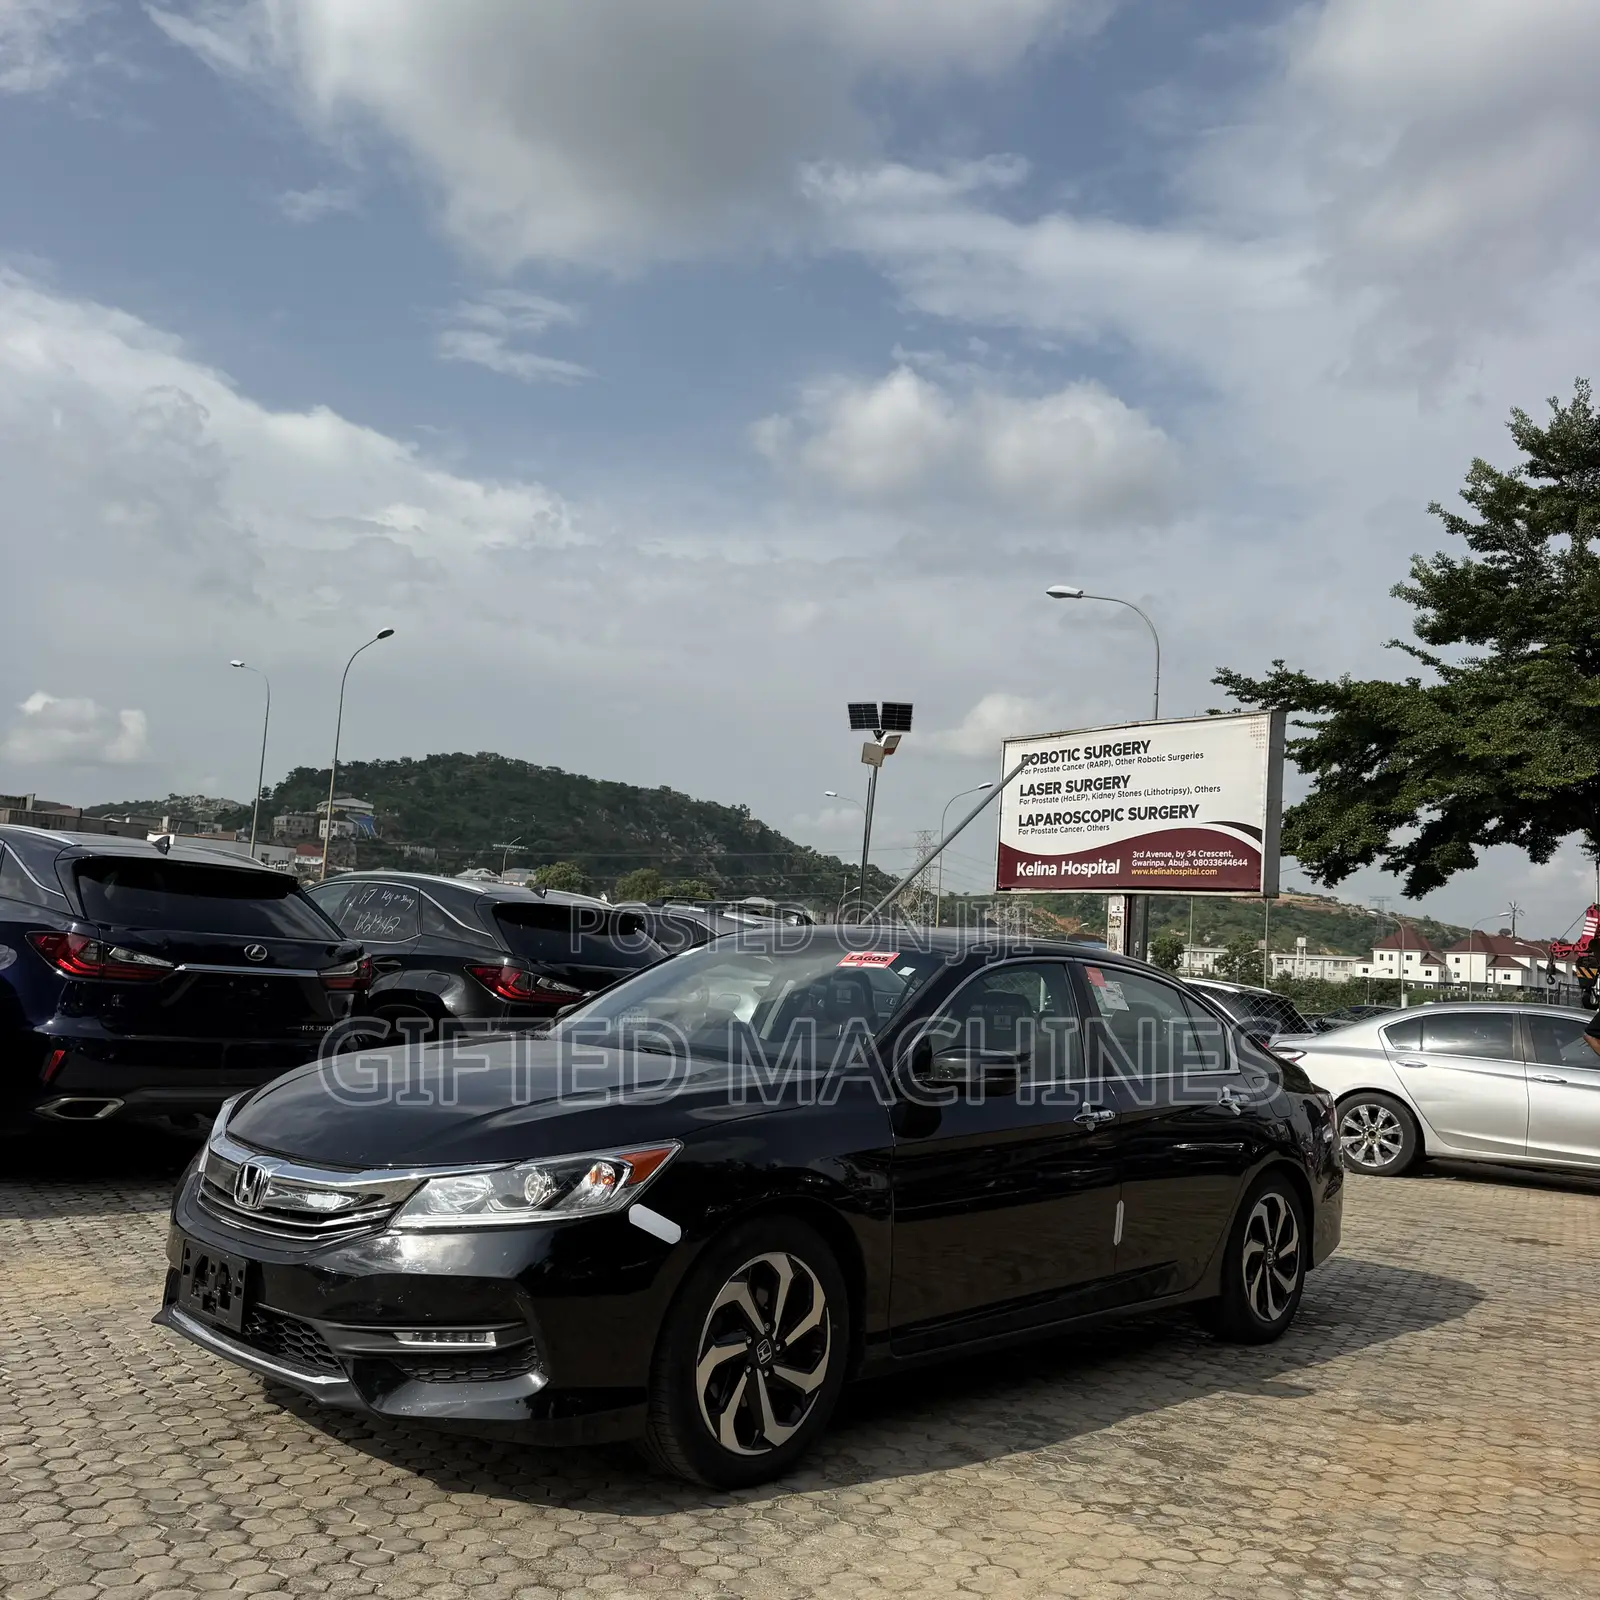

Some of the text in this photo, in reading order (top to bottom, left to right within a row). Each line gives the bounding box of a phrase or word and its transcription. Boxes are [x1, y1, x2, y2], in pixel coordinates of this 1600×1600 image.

[1084, 740, 1151, 760] SURGERY
[1033, 765, 1060, 774] Prostate
[1062, 762, 1085, 772] Cancer
[1087, 759, 1113, 769] (RARP),
[1115, 758, 1136, 766] Other
[1137, 754, 1166, 764] Robotic
[1167, 751, 1204, 762] Surgeries
[1020, 775, 1131, 797] LASER SURGERY
[1060, 793, 1091, 803] (HoLEP),
[1091, 790, 1116, 800] Kidney
[1117, 790, 1142, 798] Stones
[1143, 786, 1193, 797] (Lithotripsy),
[1194, 785, 1221, 794] Others
[1019, 804, 1199, 827] LAPAROSCOPIC SURGERY
[1086, 824, 1110, 832] Others
[1131, 859, 1249, 868] Gwarinpa, Abuja. 08033644644
[1145, 851, 1175, 859] Avenue,
[1175, 850, 1185, 859] by
[1186, 850, 1197, 858] 34
[1198, 850, 1235, 858] Crescent,
[1016, 857, 1121, 878] Kelina Hospital
[1131, 868, 1218, 876] www.kelinahospital.com
